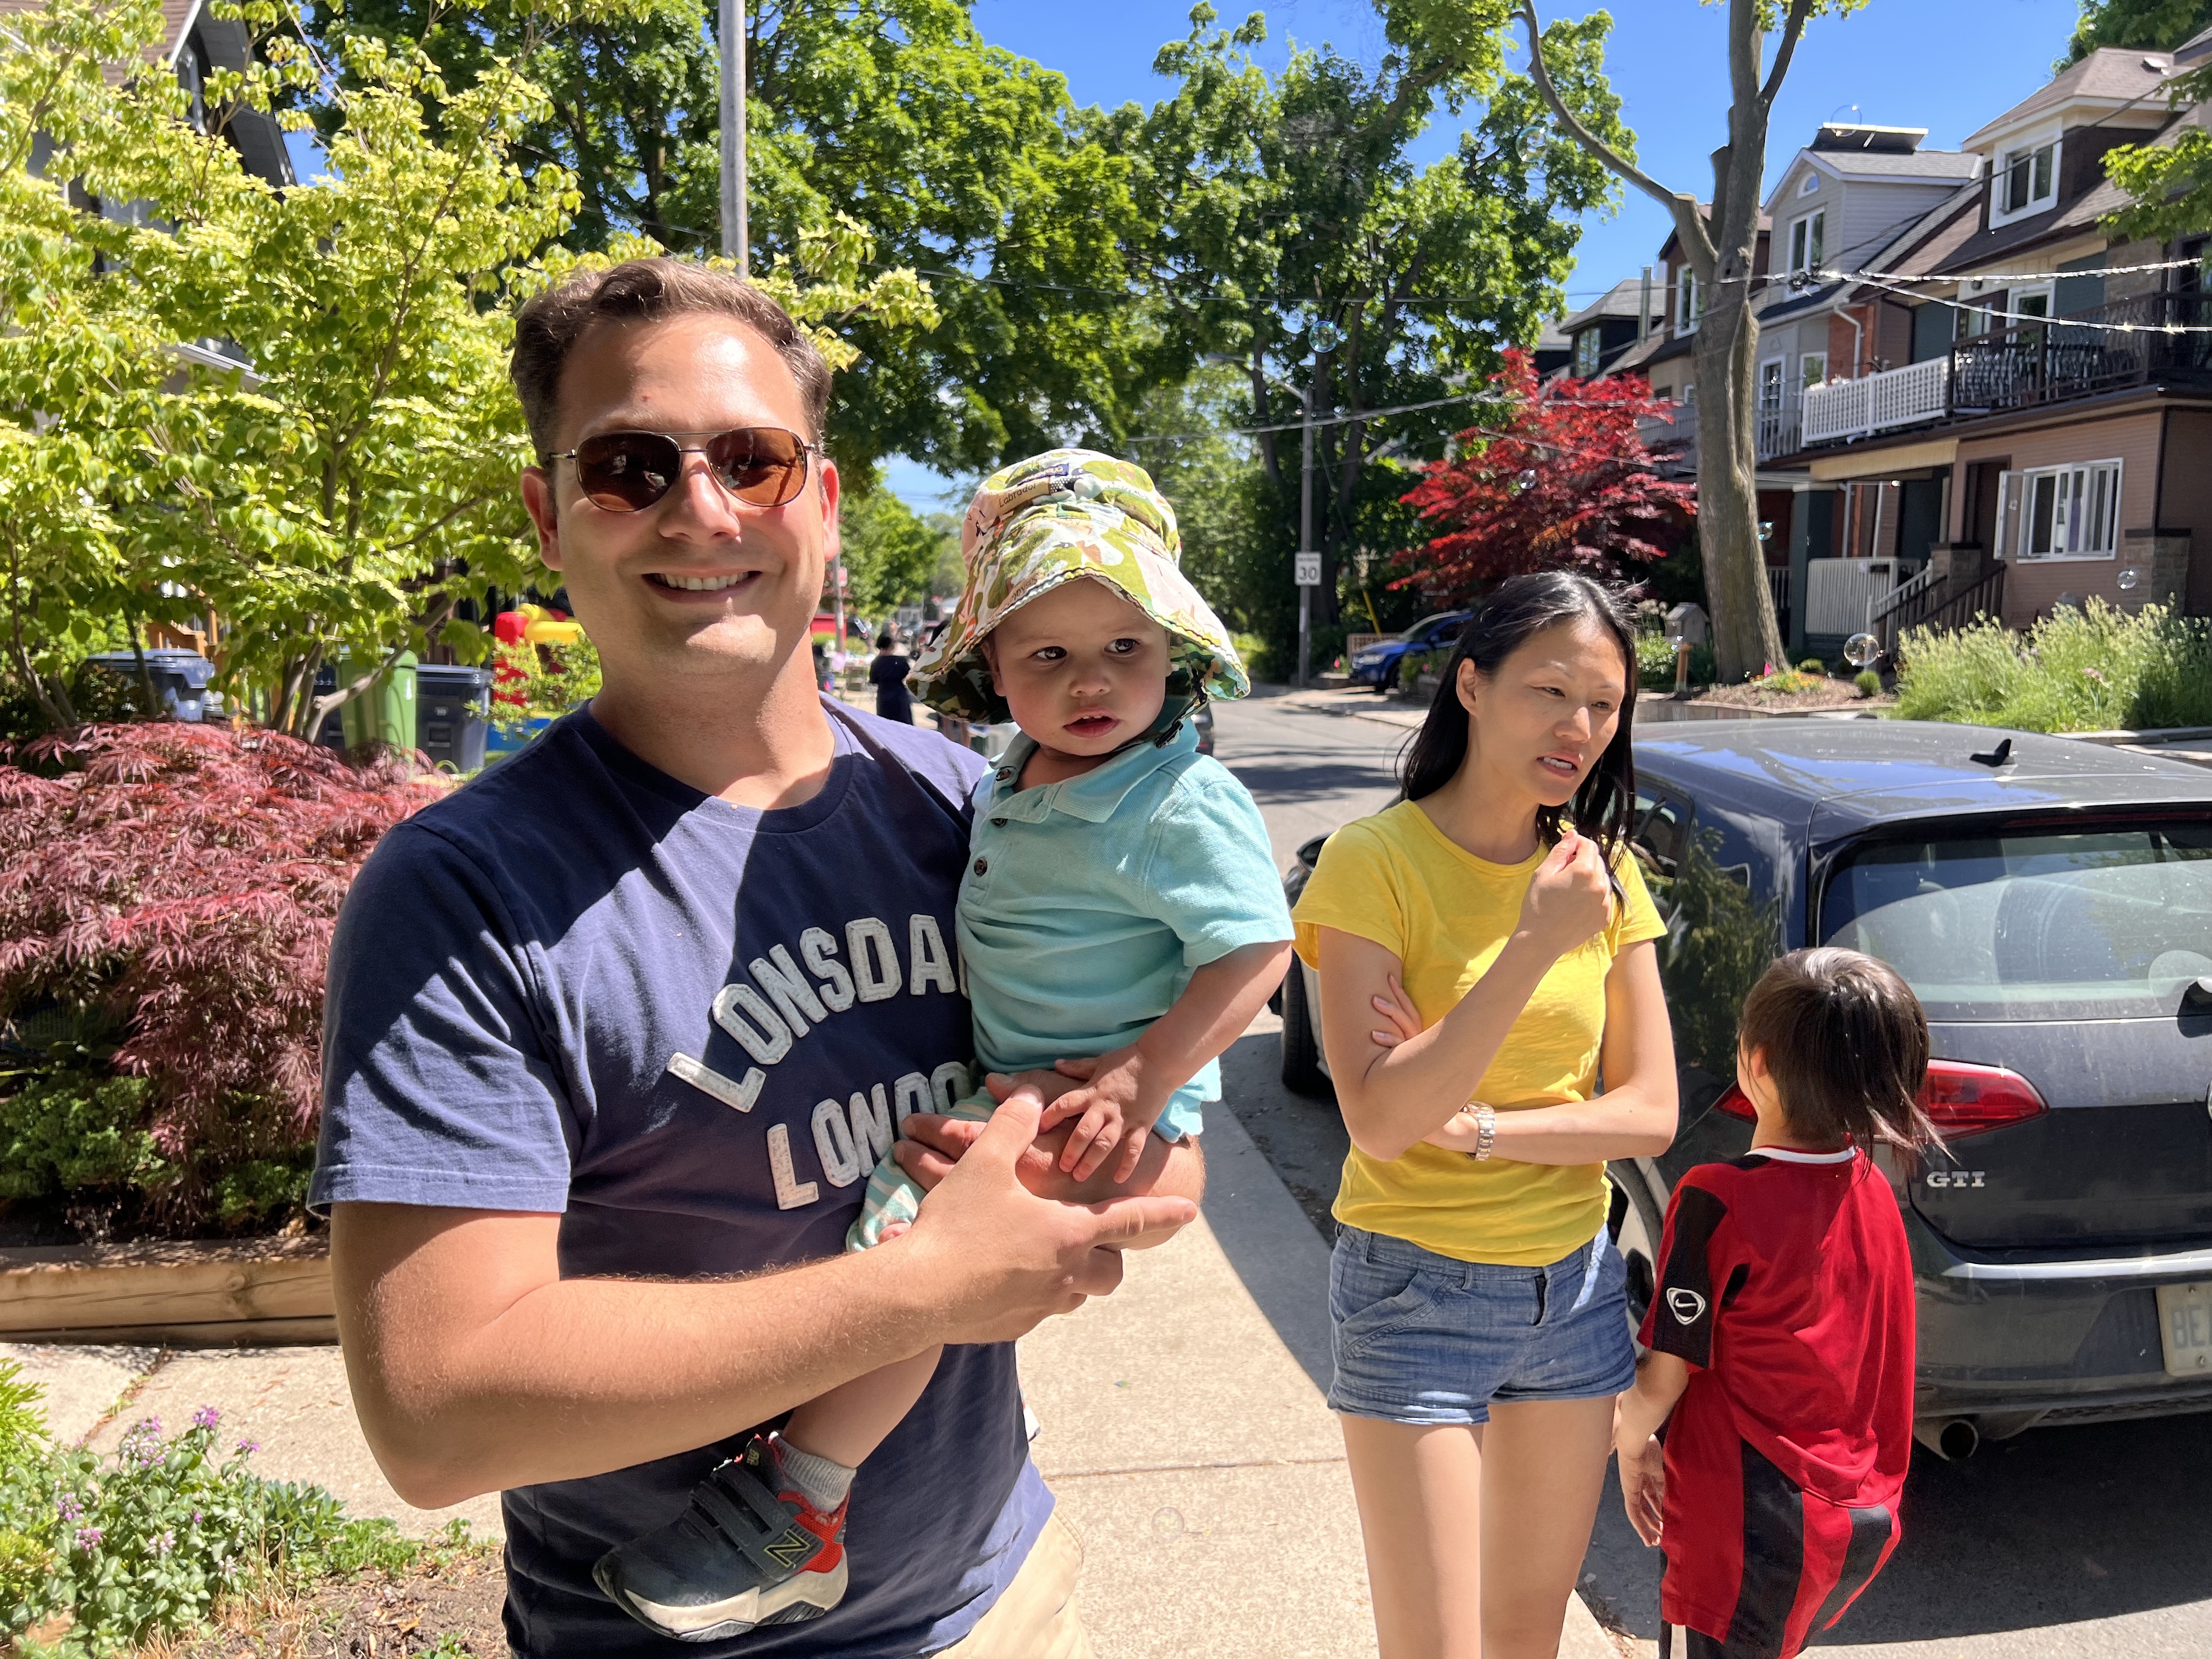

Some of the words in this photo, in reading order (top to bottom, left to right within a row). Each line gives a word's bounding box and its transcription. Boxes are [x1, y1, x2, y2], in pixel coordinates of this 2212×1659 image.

[998, 483, 1036, 508] Labrador
[1298, 566, 1318, 580] 30
[667, 913, 970, 1113] LONSDA
[768, 1061, 975, 1210] LONDO
[1927, 1171, 1985, 1188] GTI
